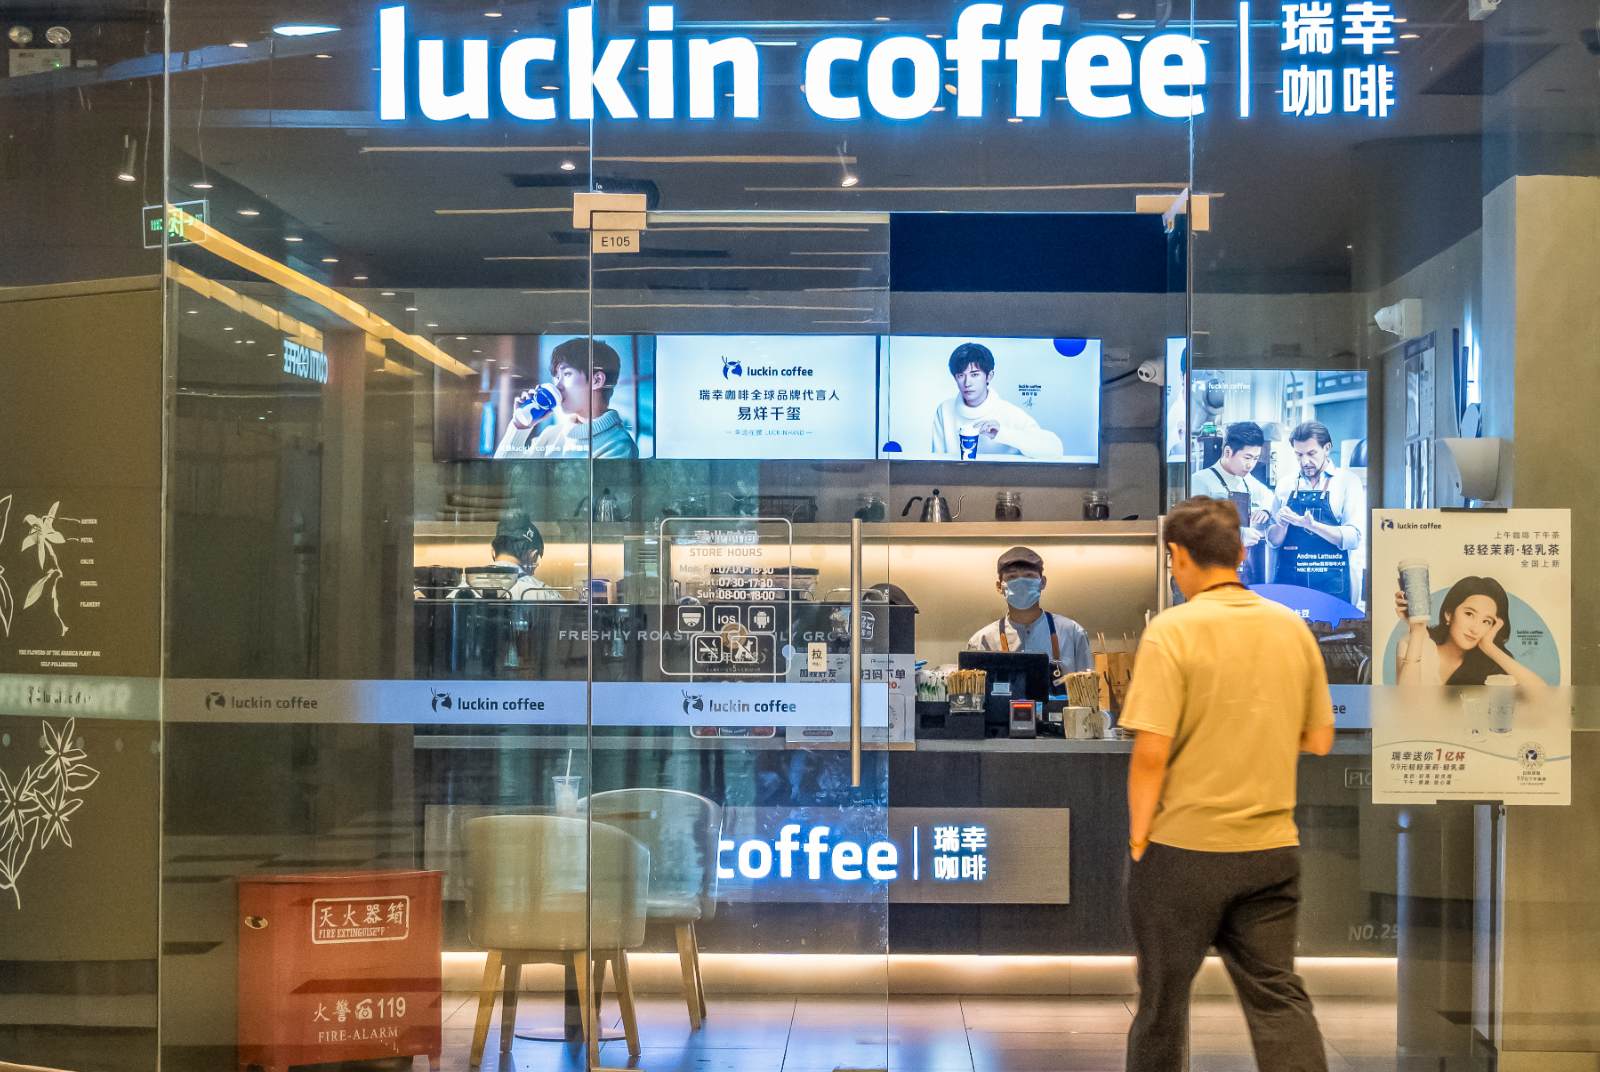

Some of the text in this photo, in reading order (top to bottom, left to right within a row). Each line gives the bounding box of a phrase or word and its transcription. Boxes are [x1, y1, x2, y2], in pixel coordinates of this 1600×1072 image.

[1281, 2, 1395, 54] 瑞幸
[379, 3, 1207, 121] luckin coffee
[1281, 65, 1396, 117] 咖啡
[601, 236, 630, 247] E105
[747, 366, 813, 376] luckin coffee
[699, 389, 840, 401] 瑞幸咖啡全球品牌代言人
[737, 406, 800, 421] 易烊千玺
[1397, 522, 1442, 530] luckin coffee
[689, 548, 763, 557] STORE HOURS
[1463, 544, 1560, 556] 轻轻茉莉·轻乳茶
[559, 630, 691, 641] FRESHLY ROAST
[811, 649, 823, 660] 拉
[231, 696, 318, 709] luckin coffee
[457, 698, 545, 710] luckin coffee
[709, 700, 797, 712] luckin coffee
[934, 826, 987, 851] 瑞幸
[934, 855, 987, 881] 咖啡
[320, 902, 404, 928] 灭火器箱
[319, 928, 336, 939] FIRE
[313, 996, 406, 1023] 火警 119
[318, 1026, 399, 1043] FIRE-ALARM
